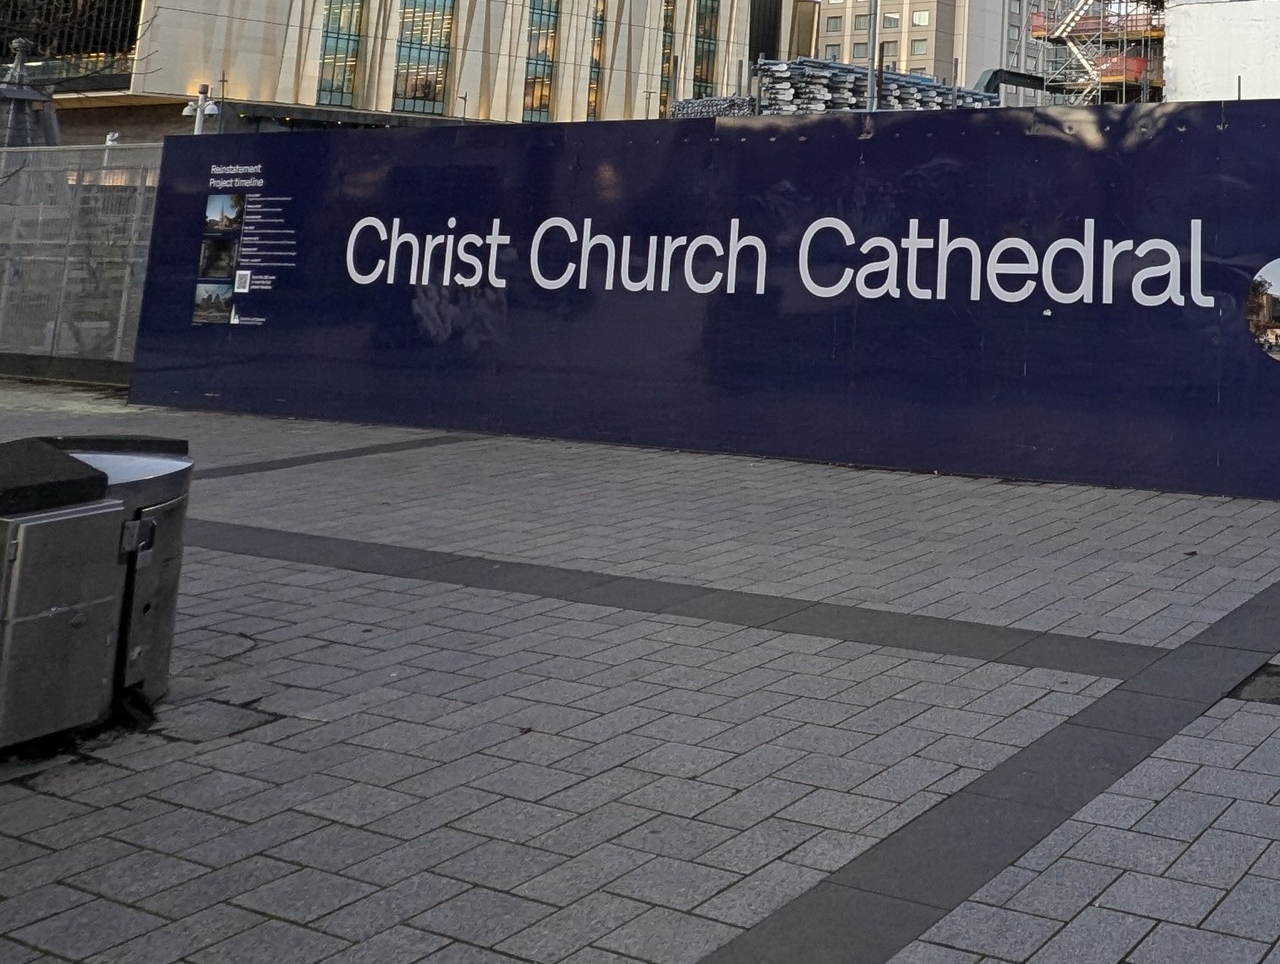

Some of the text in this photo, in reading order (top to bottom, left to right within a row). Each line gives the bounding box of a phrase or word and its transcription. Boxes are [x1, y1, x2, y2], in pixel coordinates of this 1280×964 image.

[210, 164, 262, 174] Reinstatement
[209, 178, 264, 189] Project timeline
[346, 216, 1215, 308] Christ Church Cathedral
